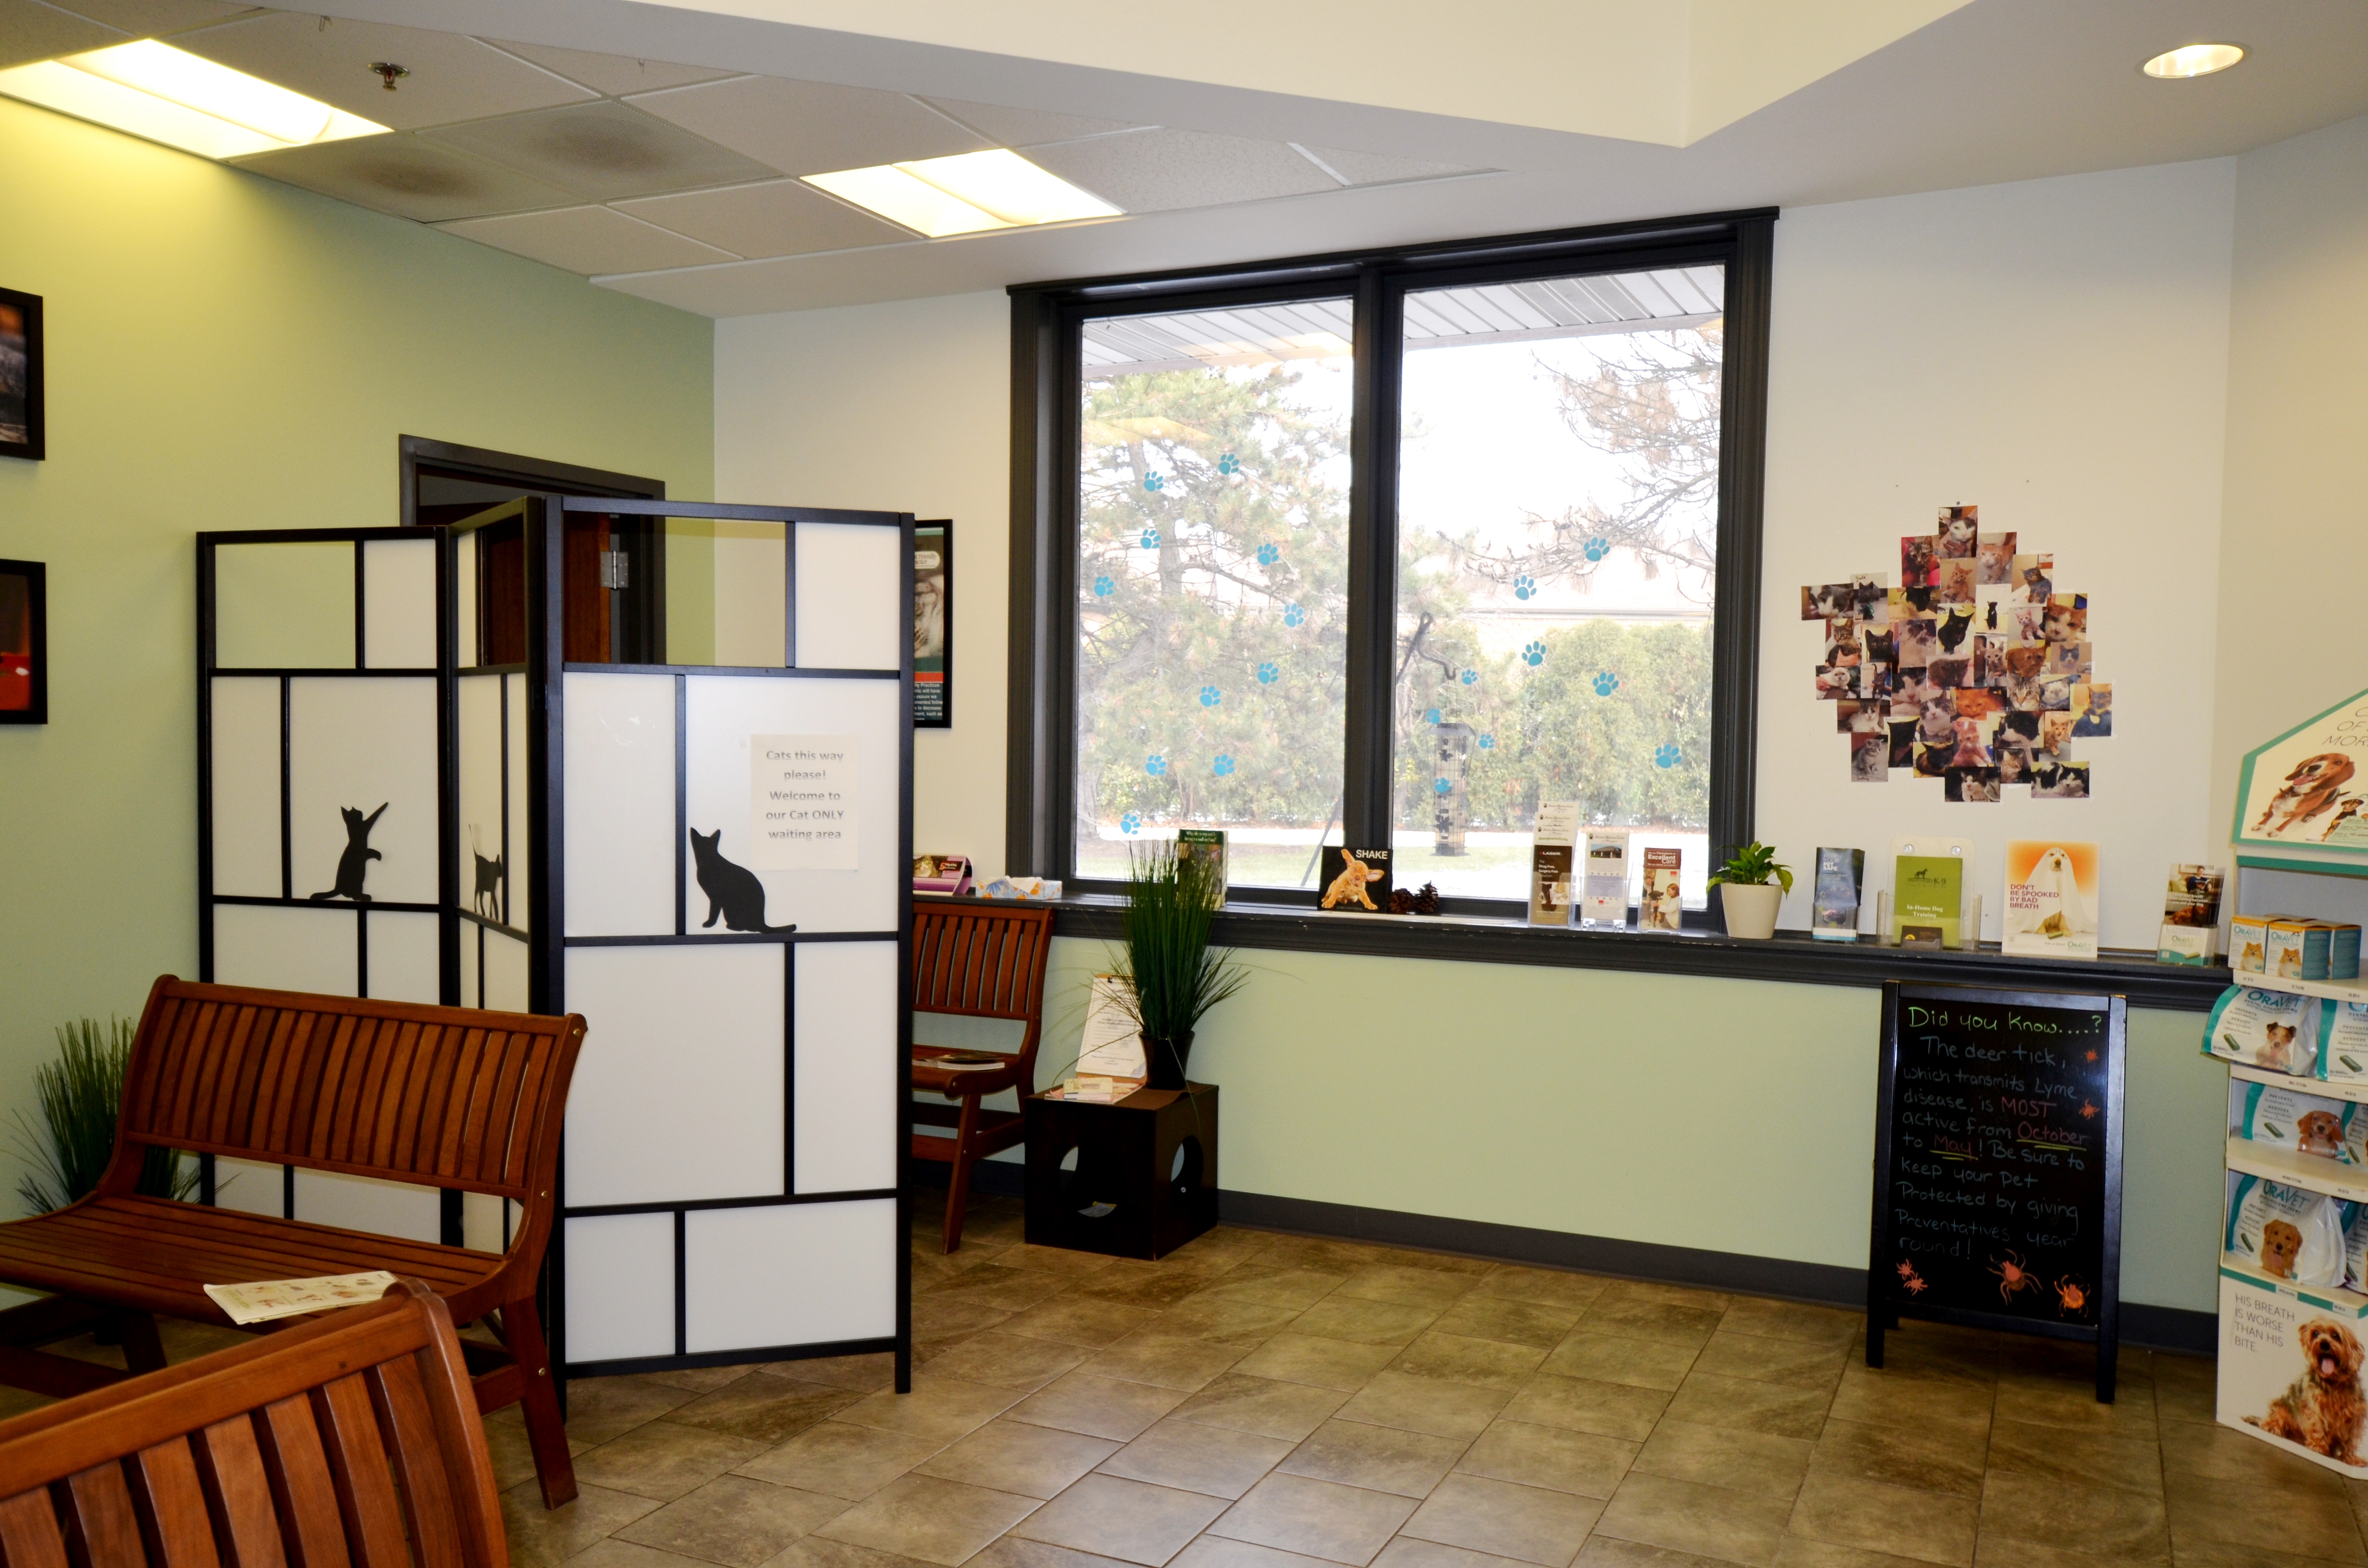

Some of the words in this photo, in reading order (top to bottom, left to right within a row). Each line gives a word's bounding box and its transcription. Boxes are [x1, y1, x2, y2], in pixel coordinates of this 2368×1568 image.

[2337, 721, 2367, 731] OF
[2321, 735, 2368, 746] MOR
[766, 750, 791, 761] Cats
[794, 750, 816, 761] this
[819, 752, 844, 763] way
[784, 770, 826, 782] please!
[769, 790, 825, 801] Welcome
[828, 792, 841, 801] to
[765, 811, 787, 821] our
[789, 809, 809, 820] Cat
[812, 810, 844, 821] ONLY
[768, 829, 813, 841] waiting
[815, 831, 841, 839] area
[1356, 849, 1388, 859] SHAKE
[1908, 1006, 1948, 1028] Did
[1960, 1014, 1998, 1031] you
[1920, 1035, 1959, 1058] The
[1964, 1043, 2007, 1061] deer
[2012, 1043, 2066, 1069] tick,
[1903, 1067, 1950, 1083] which
[1954, 1068, 2025, 1093] transmits
[2035, 1077, 2078, 1100] Lyme
[1903, 1089, 1973, 1114] disease,
[1978, 1096, 1994, 1112] is
[2001, 1096, 2057, 1118] MOST
[1902, 1111, 1961, 1133] active
[1966, 1117, 2012, 1140] from
[2018, 1122, 2091, 1146] October
[1902, 1131, 1923, 1148] to
[1934, 1134, 1984, 1159] May!
[1987, 1139, 2017, 1160] Be
[2067, 1152, 2085, 1171] to
[1953, 1168, 1993, 1183] your
[1996, 1194, 2017, 1215] by
[2027, 1197, 2079, 1236] giving
[1899, 1237, 1971, 1260] round!
[2026, 1230, 2075, 1248] year
[2235, 1293, 2252, 1307] HIS
[2255, 1299, 2295, 1322] BREATH
[2235, 1308, 2244, 1319] IS
[2246, 1311, 2283, 1332] WORSE
[2235, 1322, 2264, 1340] THAN
[2267, 1335, 2283, 1347] HIS
[2235, 1336, 2258, 1353] BITE.
